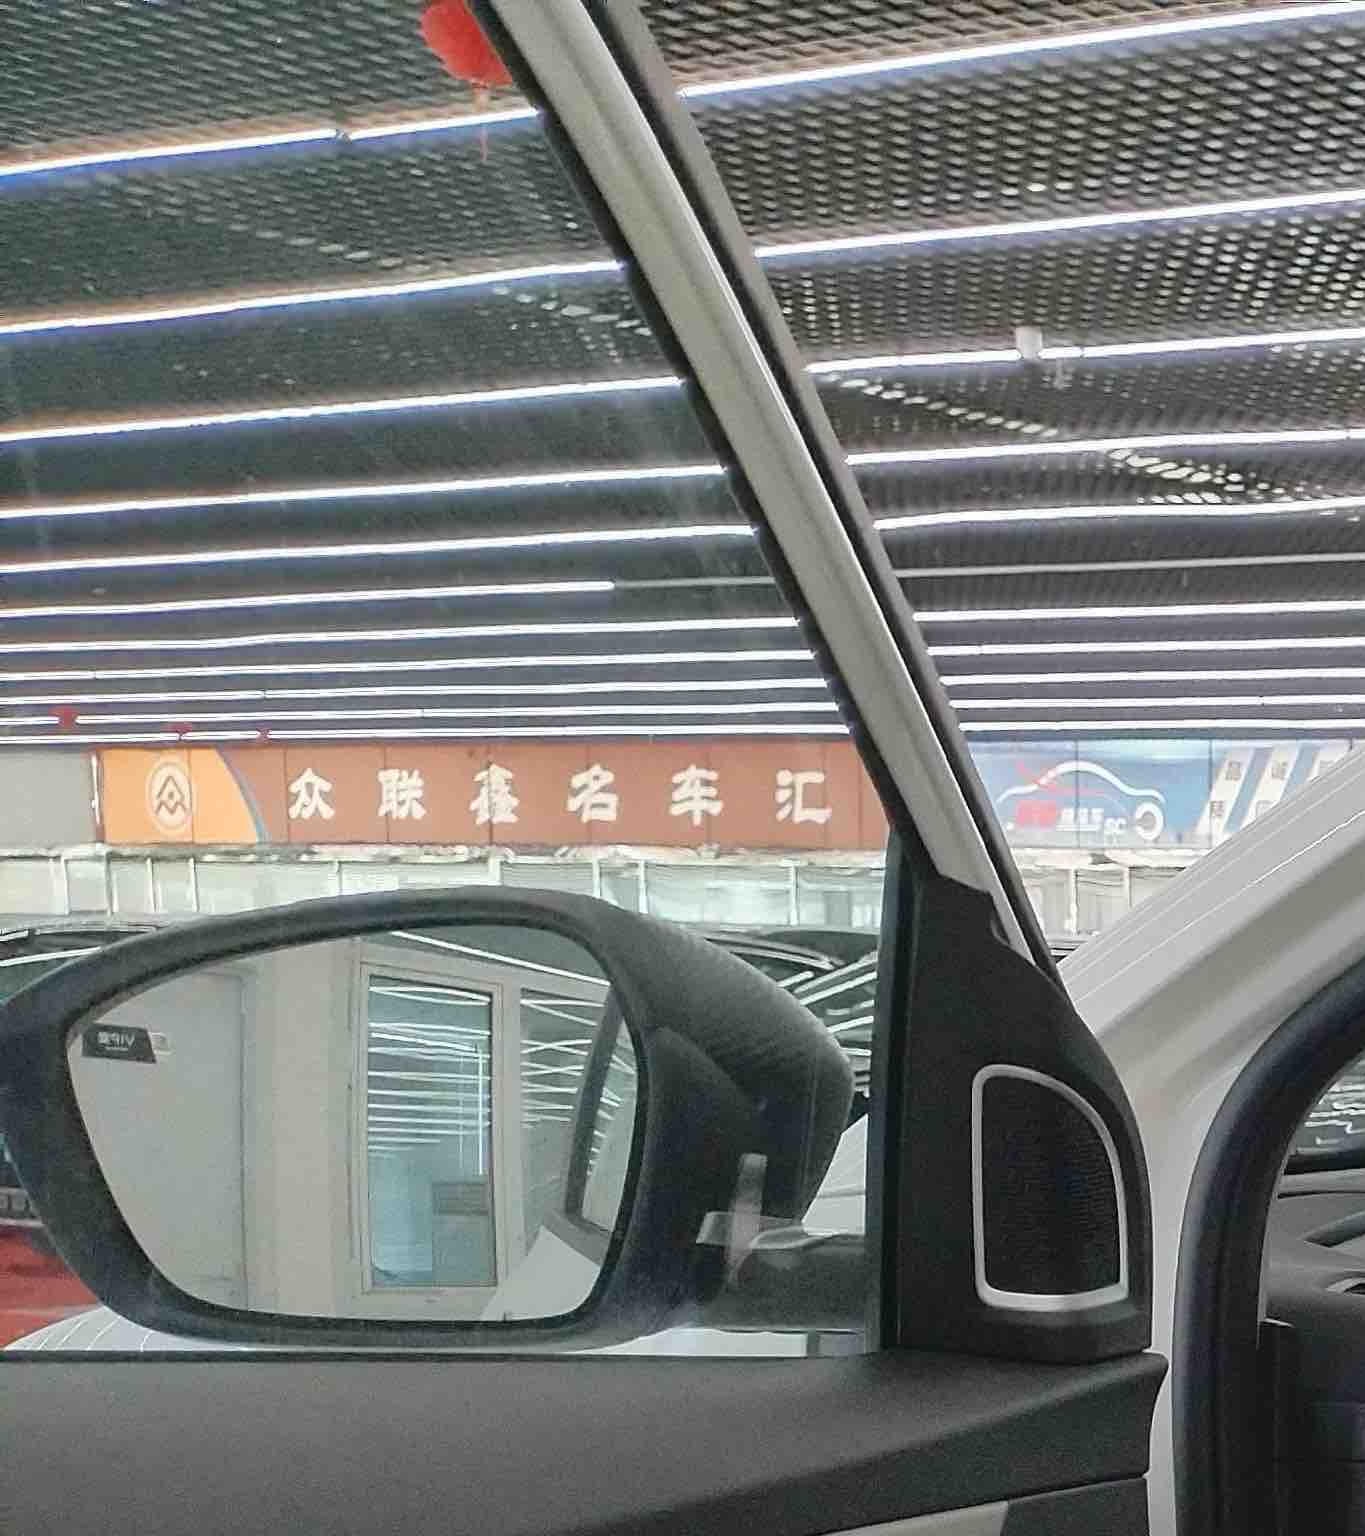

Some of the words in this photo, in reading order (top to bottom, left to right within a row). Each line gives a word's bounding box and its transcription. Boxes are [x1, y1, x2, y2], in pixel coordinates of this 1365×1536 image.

[288, 764, 832, 825] 众联鑫名车汇
